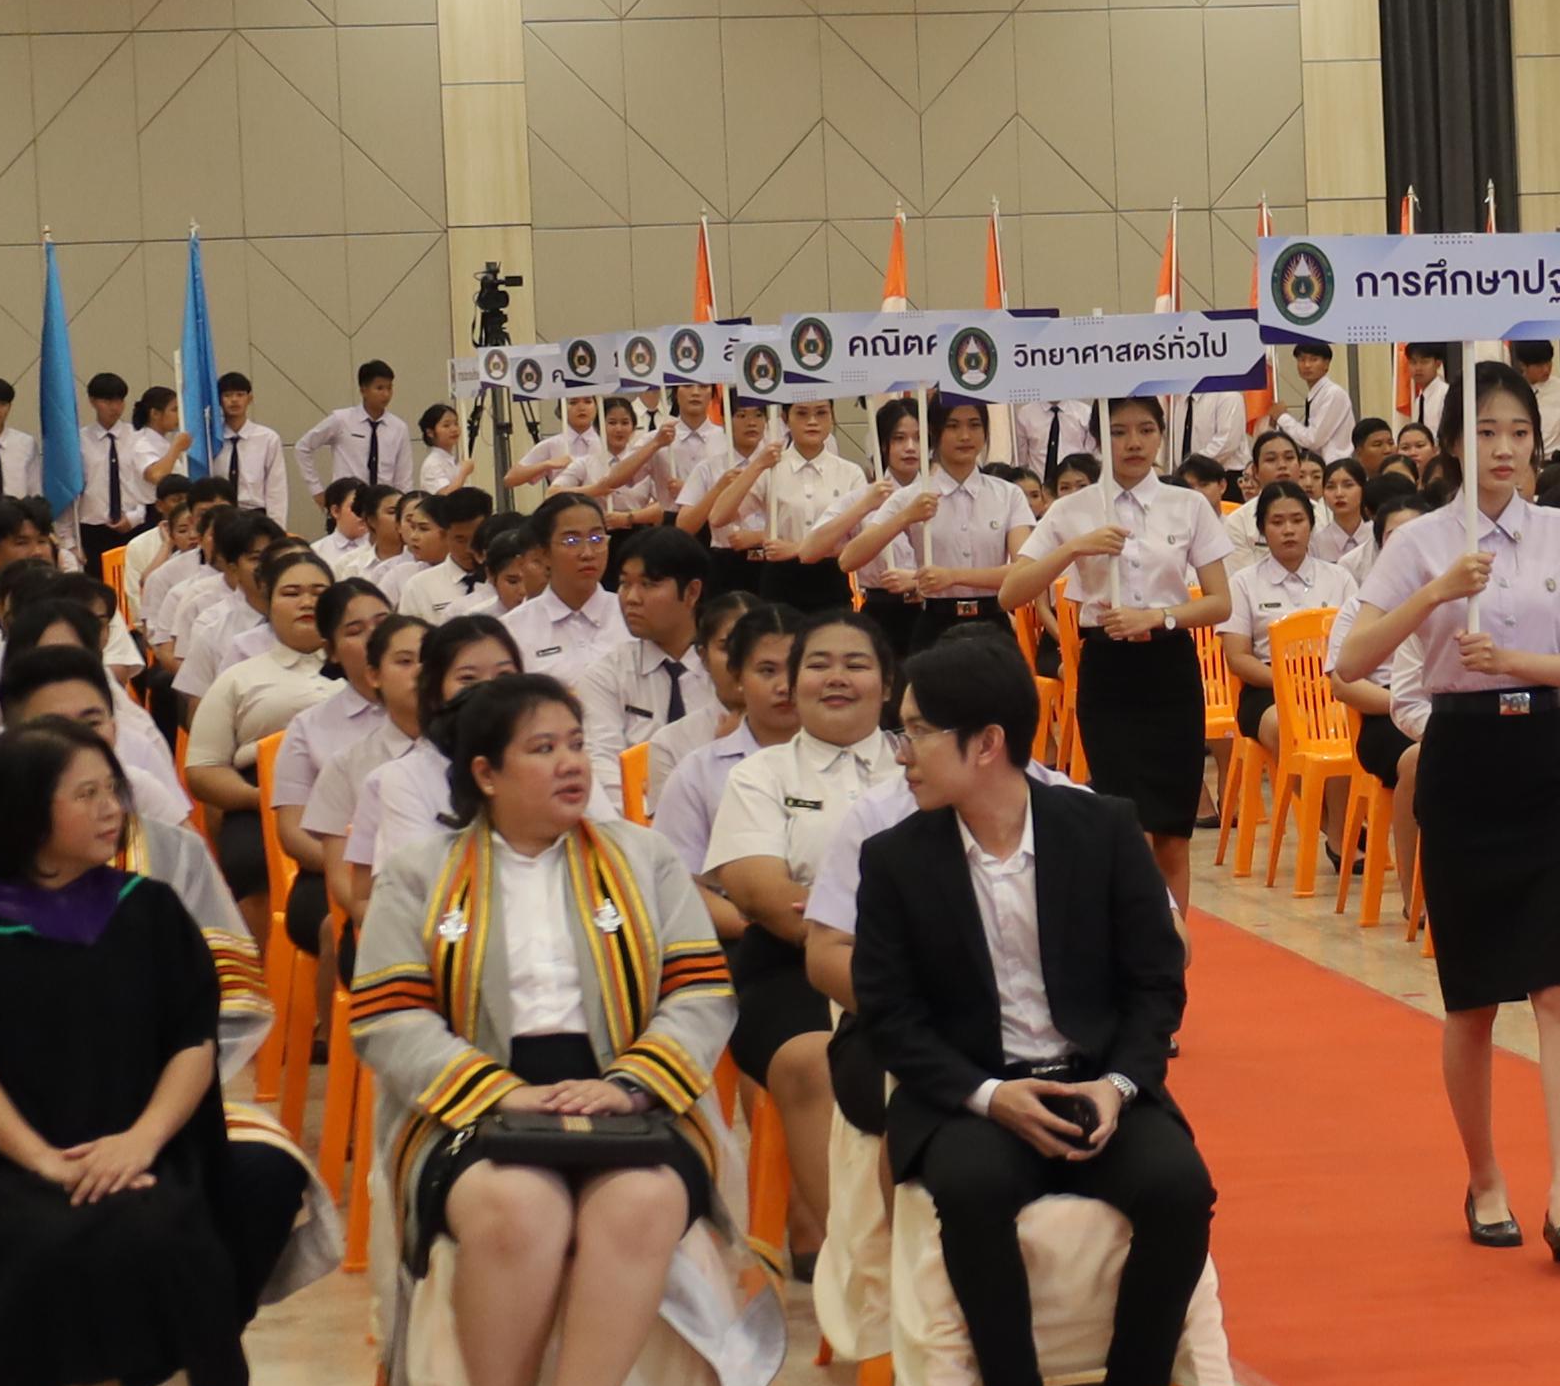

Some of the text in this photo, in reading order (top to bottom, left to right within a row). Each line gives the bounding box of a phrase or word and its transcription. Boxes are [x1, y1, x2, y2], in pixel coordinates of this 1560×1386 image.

[1013, 326, 1228, 368] วิทยาศาสตร์ทั่วไป
